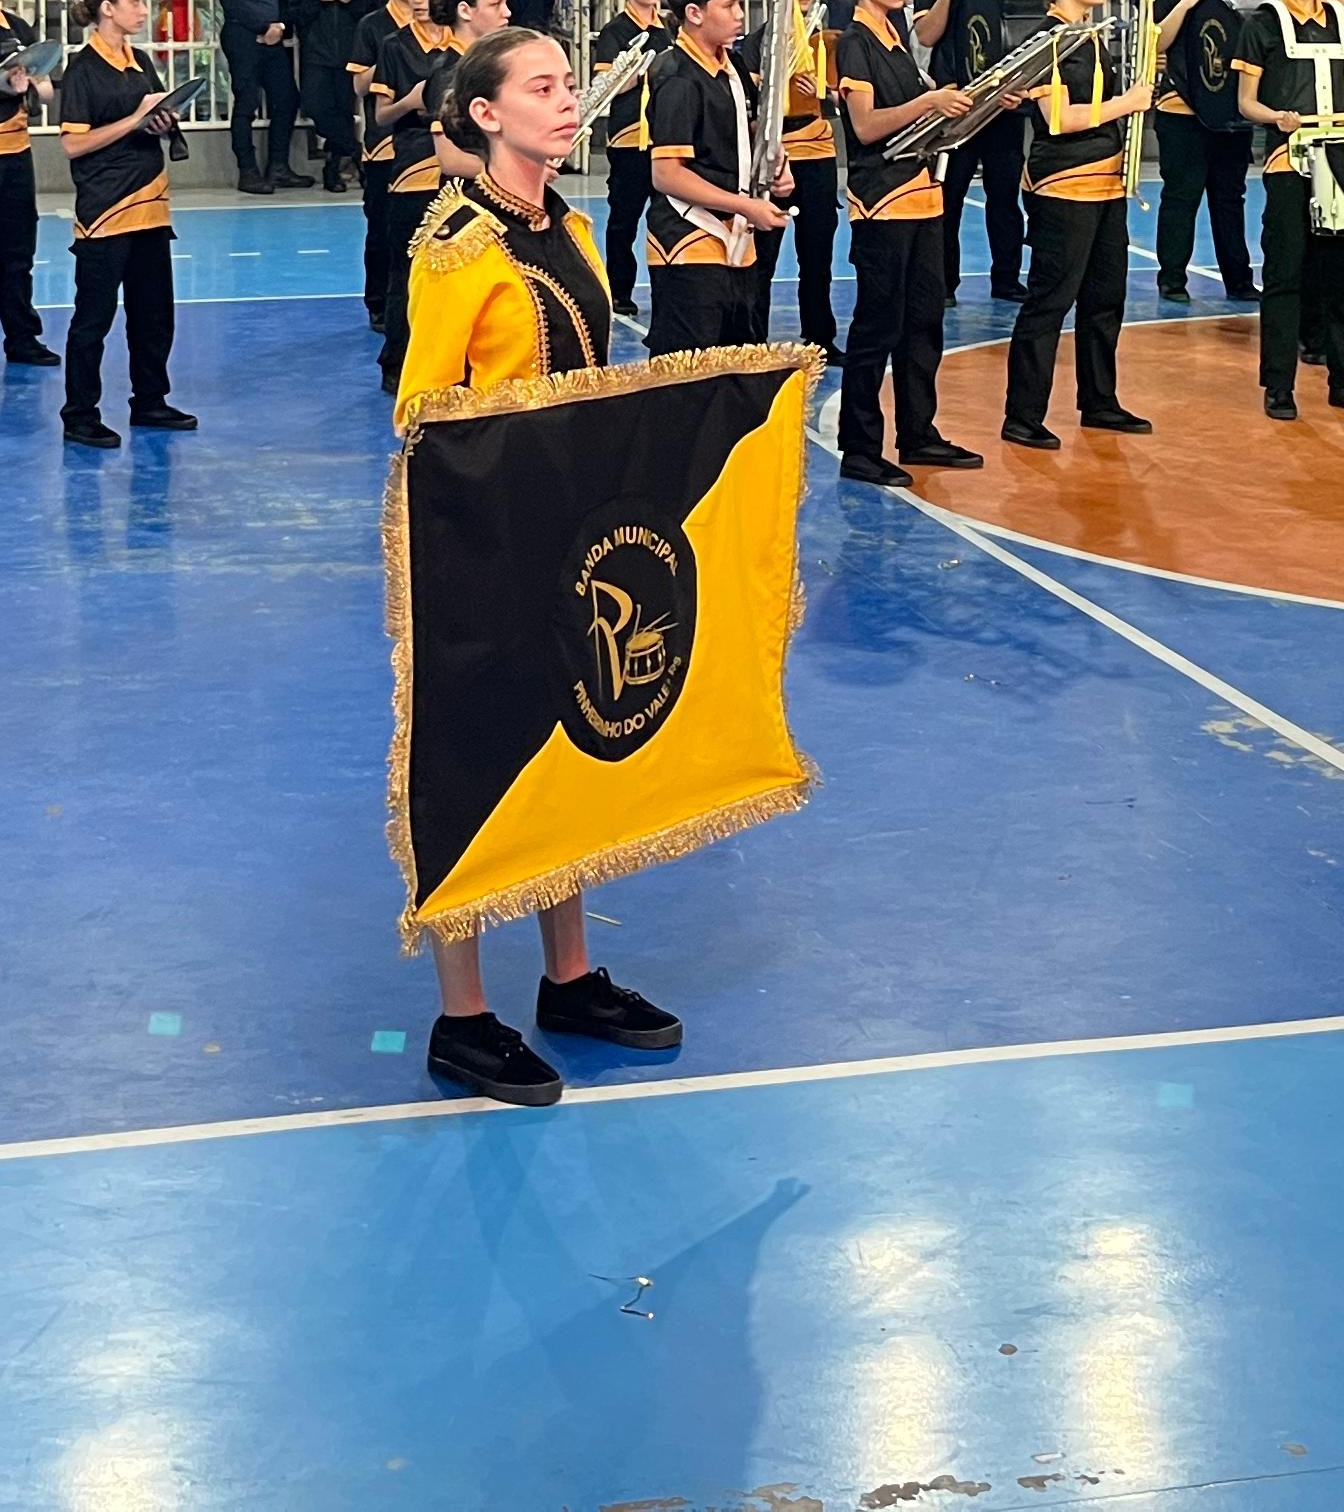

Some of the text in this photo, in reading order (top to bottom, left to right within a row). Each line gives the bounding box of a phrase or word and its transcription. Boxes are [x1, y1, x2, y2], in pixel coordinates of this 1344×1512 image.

[575, 536, 614, 596] BANDA
[573, 679, 623, 738] PINHENHO
[623, 713, 646, 736] DO
[644, 681, 671, 719] VALE
